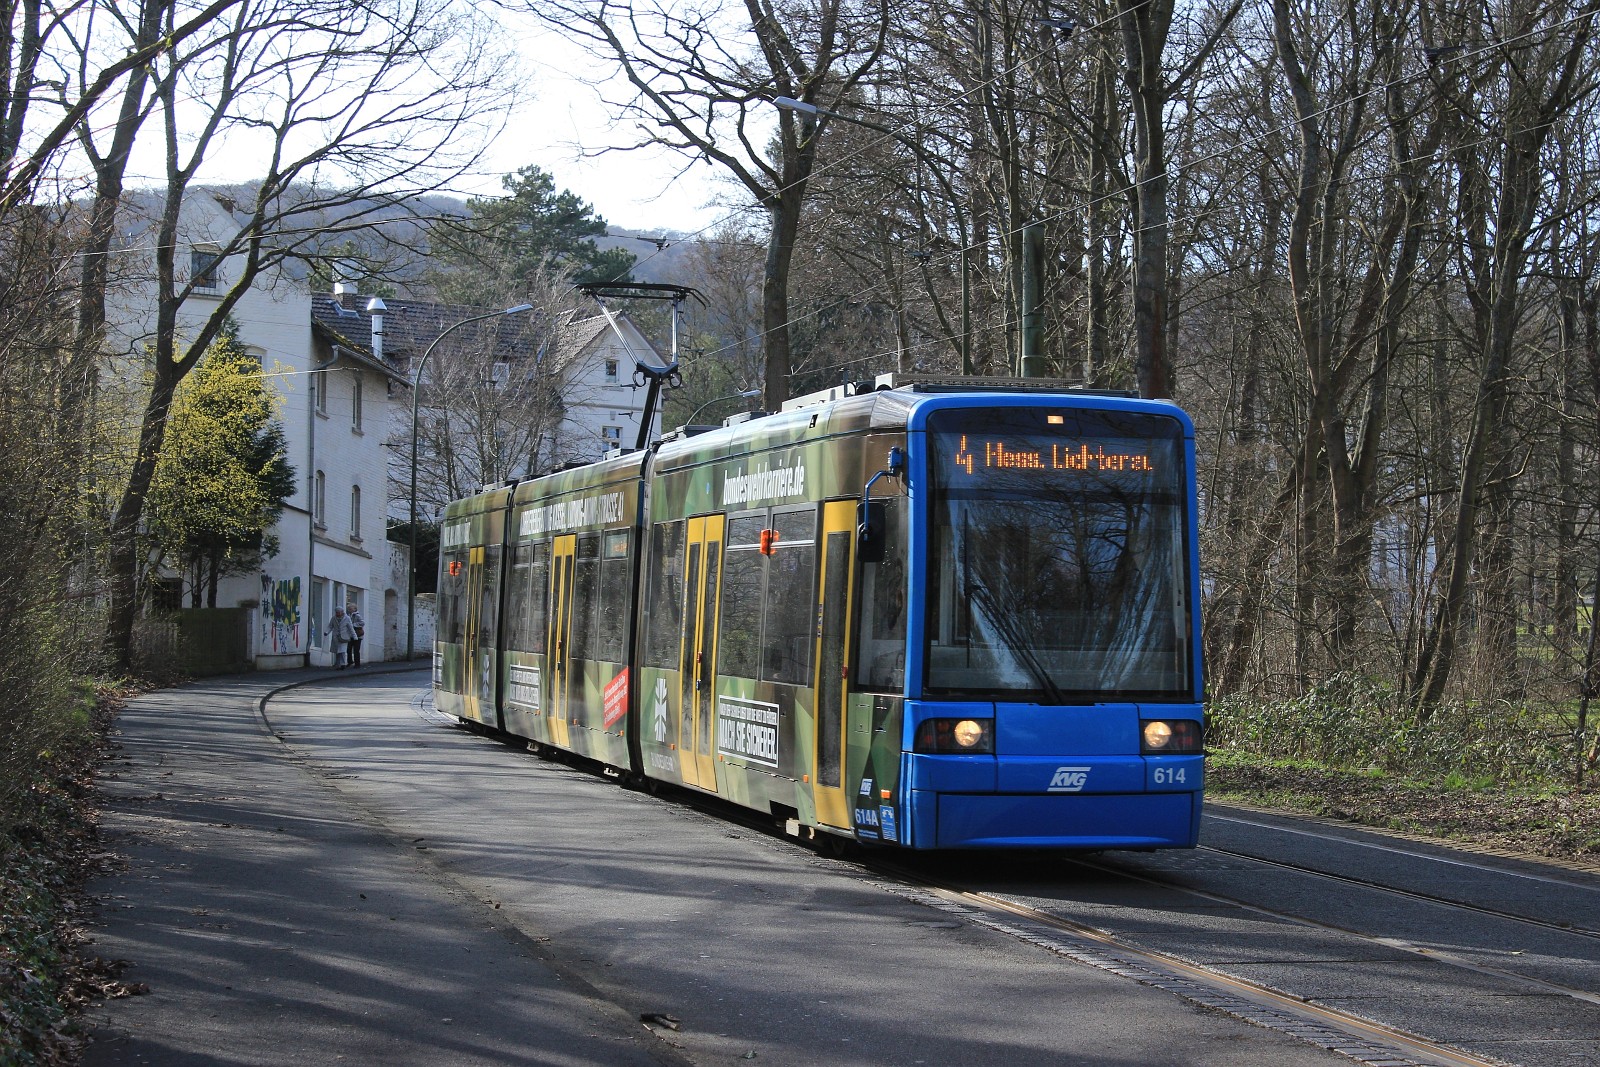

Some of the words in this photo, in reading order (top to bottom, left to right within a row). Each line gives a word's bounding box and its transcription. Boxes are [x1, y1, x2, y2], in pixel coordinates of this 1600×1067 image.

[956, 435, 972, 475] 4
[986, 442, 1045, 469] Hess.
[723, 456, 805, 506] bundeswehrkarriere.de
[1049, 769, 1090, 789] KVG
[1154, 768, 1186, 784] 614
[855, 808, 879, 827] 614A
